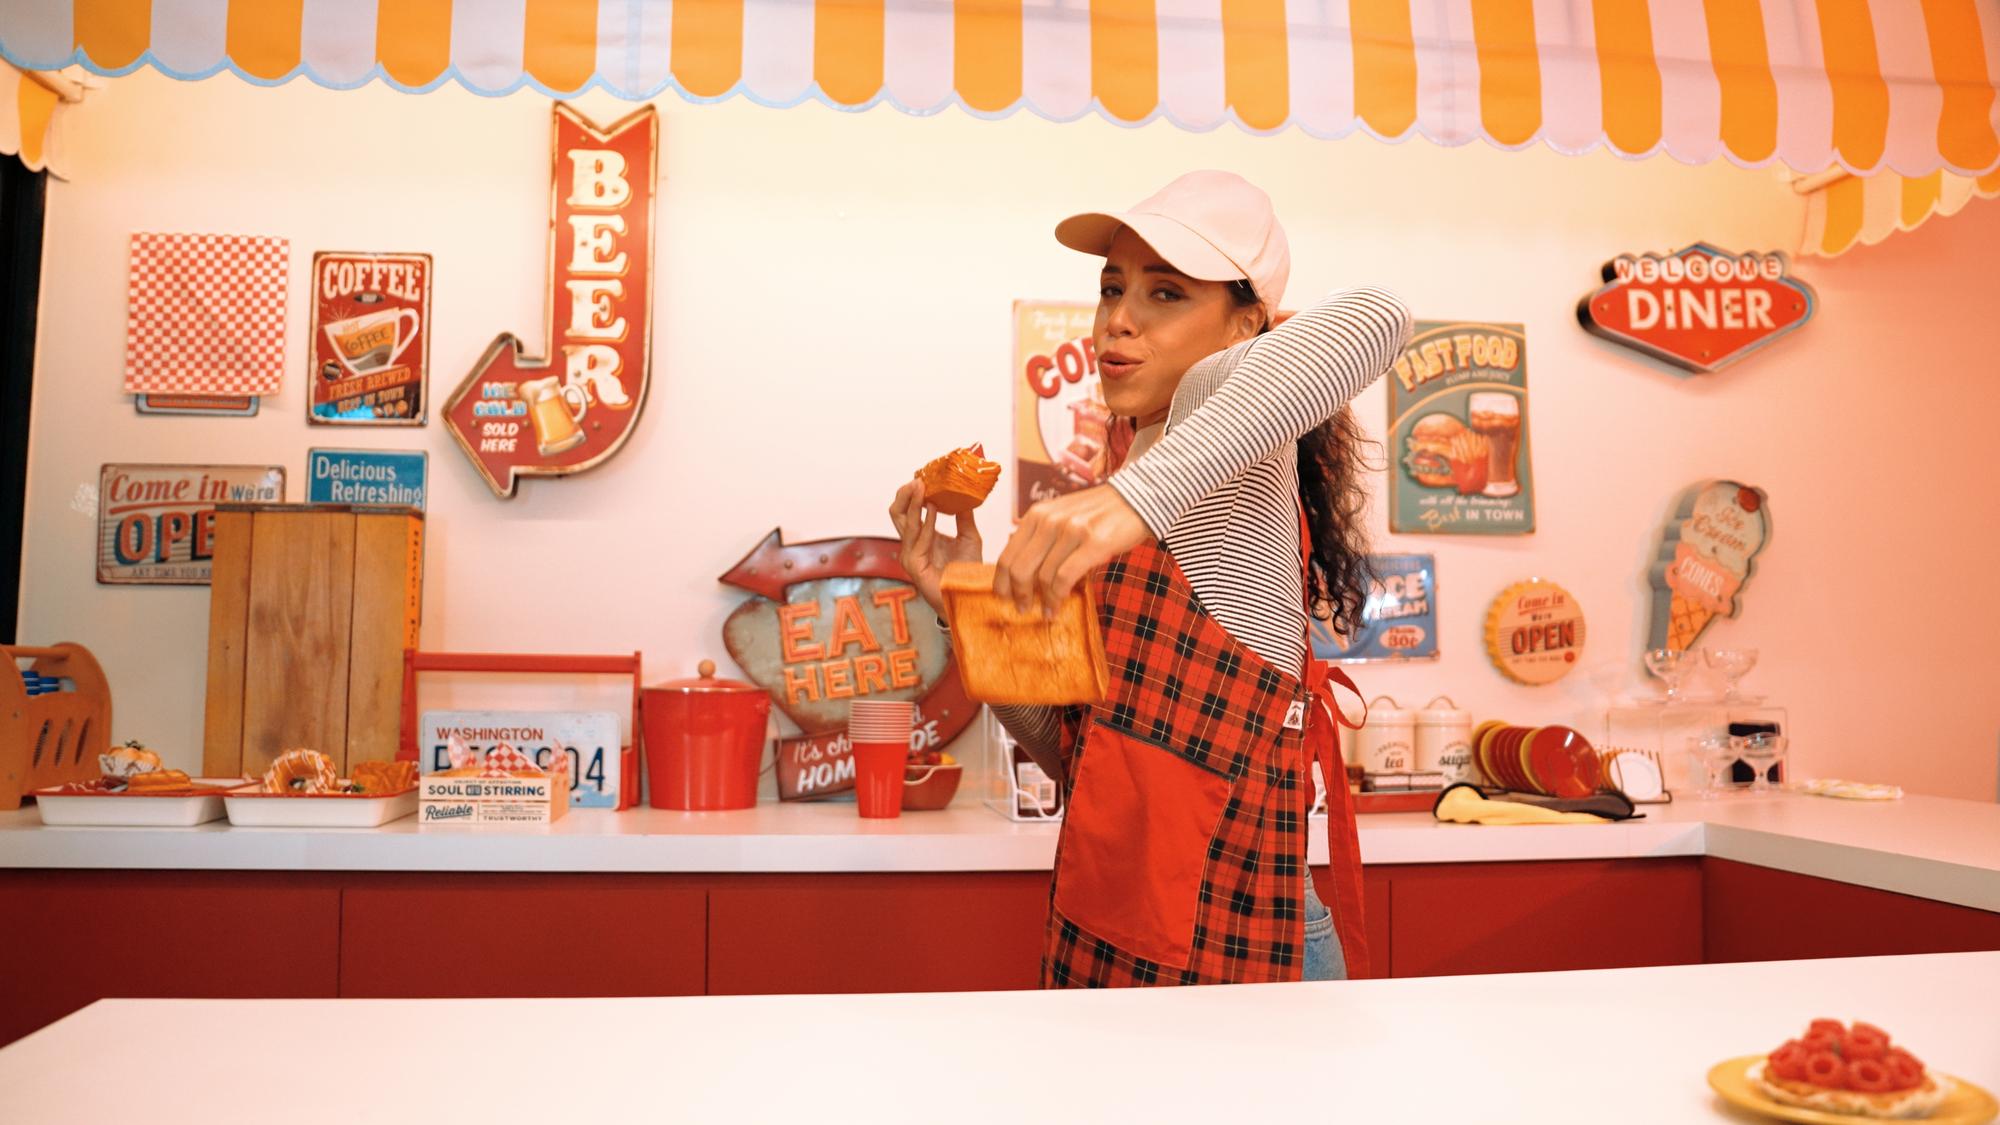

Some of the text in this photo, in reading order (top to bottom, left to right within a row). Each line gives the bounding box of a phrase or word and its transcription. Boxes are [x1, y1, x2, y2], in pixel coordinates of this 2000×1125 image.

[563, 149, 632, 409] BEER
[1615, 258, 1779, 278] WELCOME
[323, 261, 420, 301] COFFEE
[1627, 289, 1776, 329] DINER
[1026, 337, 1098, 399] COF
[1395, 335, 1519, 392] FAST FOOD
[330, 367, 411, 400] FRESH BREWED
[482, 382, 517, 398] ICE
[473, 401, 526, 416] COLD
[482, 422, 519, 437] SOLD
[480, 438, 517, 452] HERE
[316, 456, 397, 481] Delicious
[110, 474, 275, 502] Come in We're
[331, 481, 422, 506] Refreshing
[1465, 509, 1479, 520] IN
[1485, 509, 1525, 520] TOWN
[114, 510, 215, 565] OPE
[1680, 556, 1725, 597] CONES
[777, 587, 917, 663] EAT
[1511, 620, 1575, 656] OPEN
[783, 647, 922, 705] HERE
[436, 727, 545, 741] WASHINGTON
[794, 740, 823, 764] It's
[1384, 756, 1404, 769] tea
[1438, 755, 1472, 770] suga
[428, 784, 464, 795] SOUL
[484, 784, 545, 797] STIRRING
[425, 803, 473, 821] Reliable
